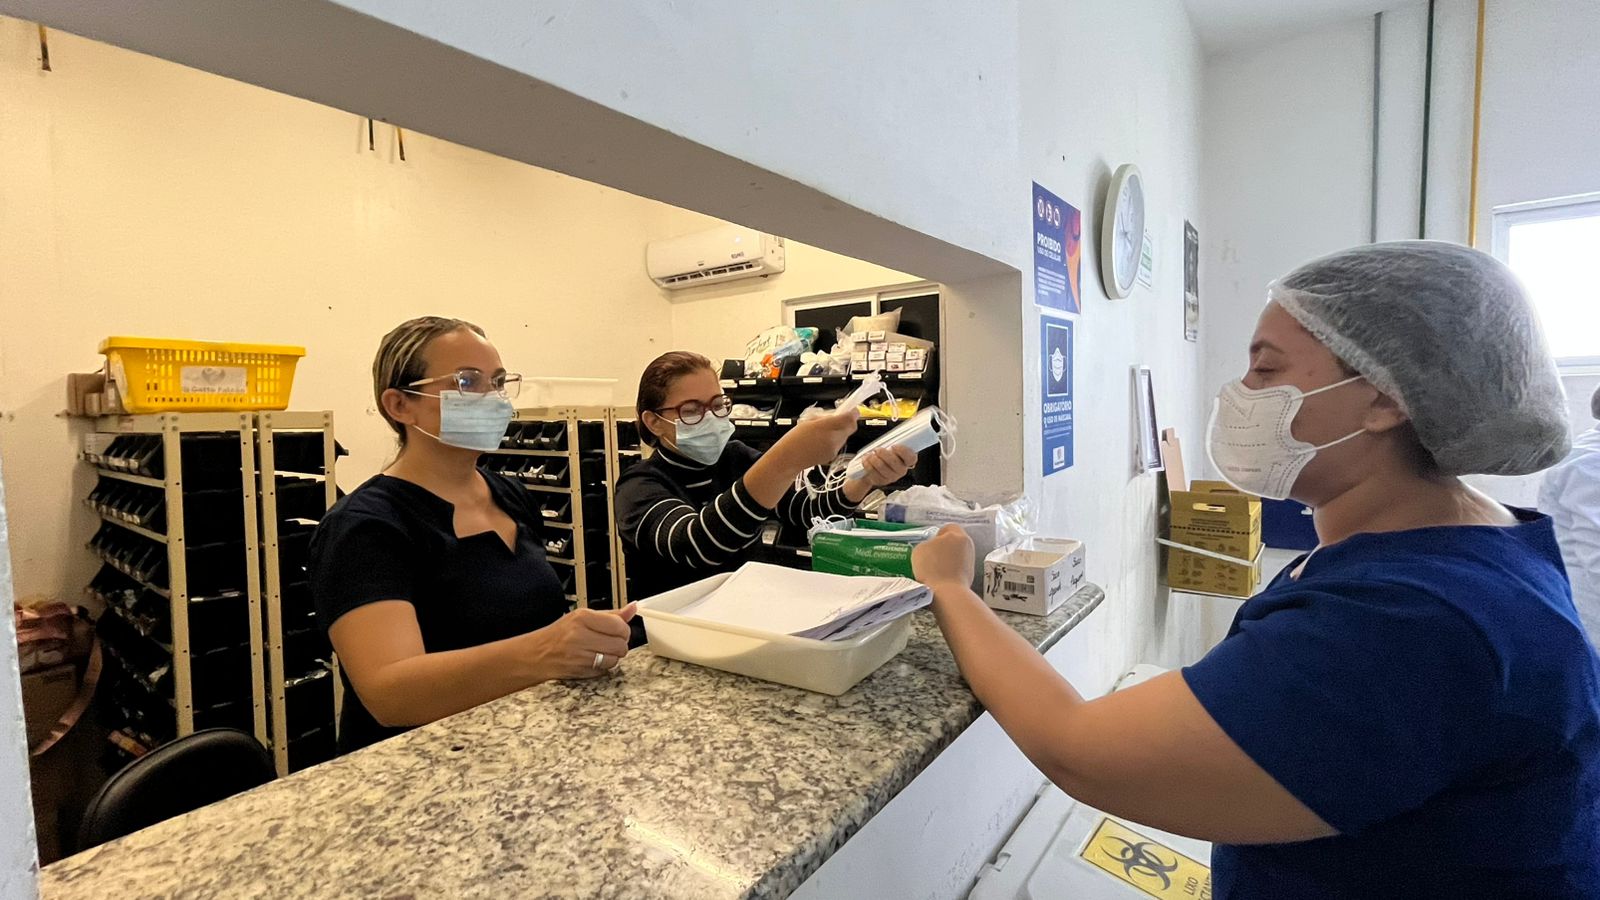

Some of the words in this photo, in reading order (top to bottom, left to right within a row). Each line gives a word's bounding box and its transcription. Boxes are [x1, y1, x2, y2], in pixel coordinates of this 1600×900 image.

[1037, 231, 1061, 253] PROIBIDO
[1044, 399, 1072, 413] OBRIGATÓRIO
[1184, 877, 1199, 896] LIXO
